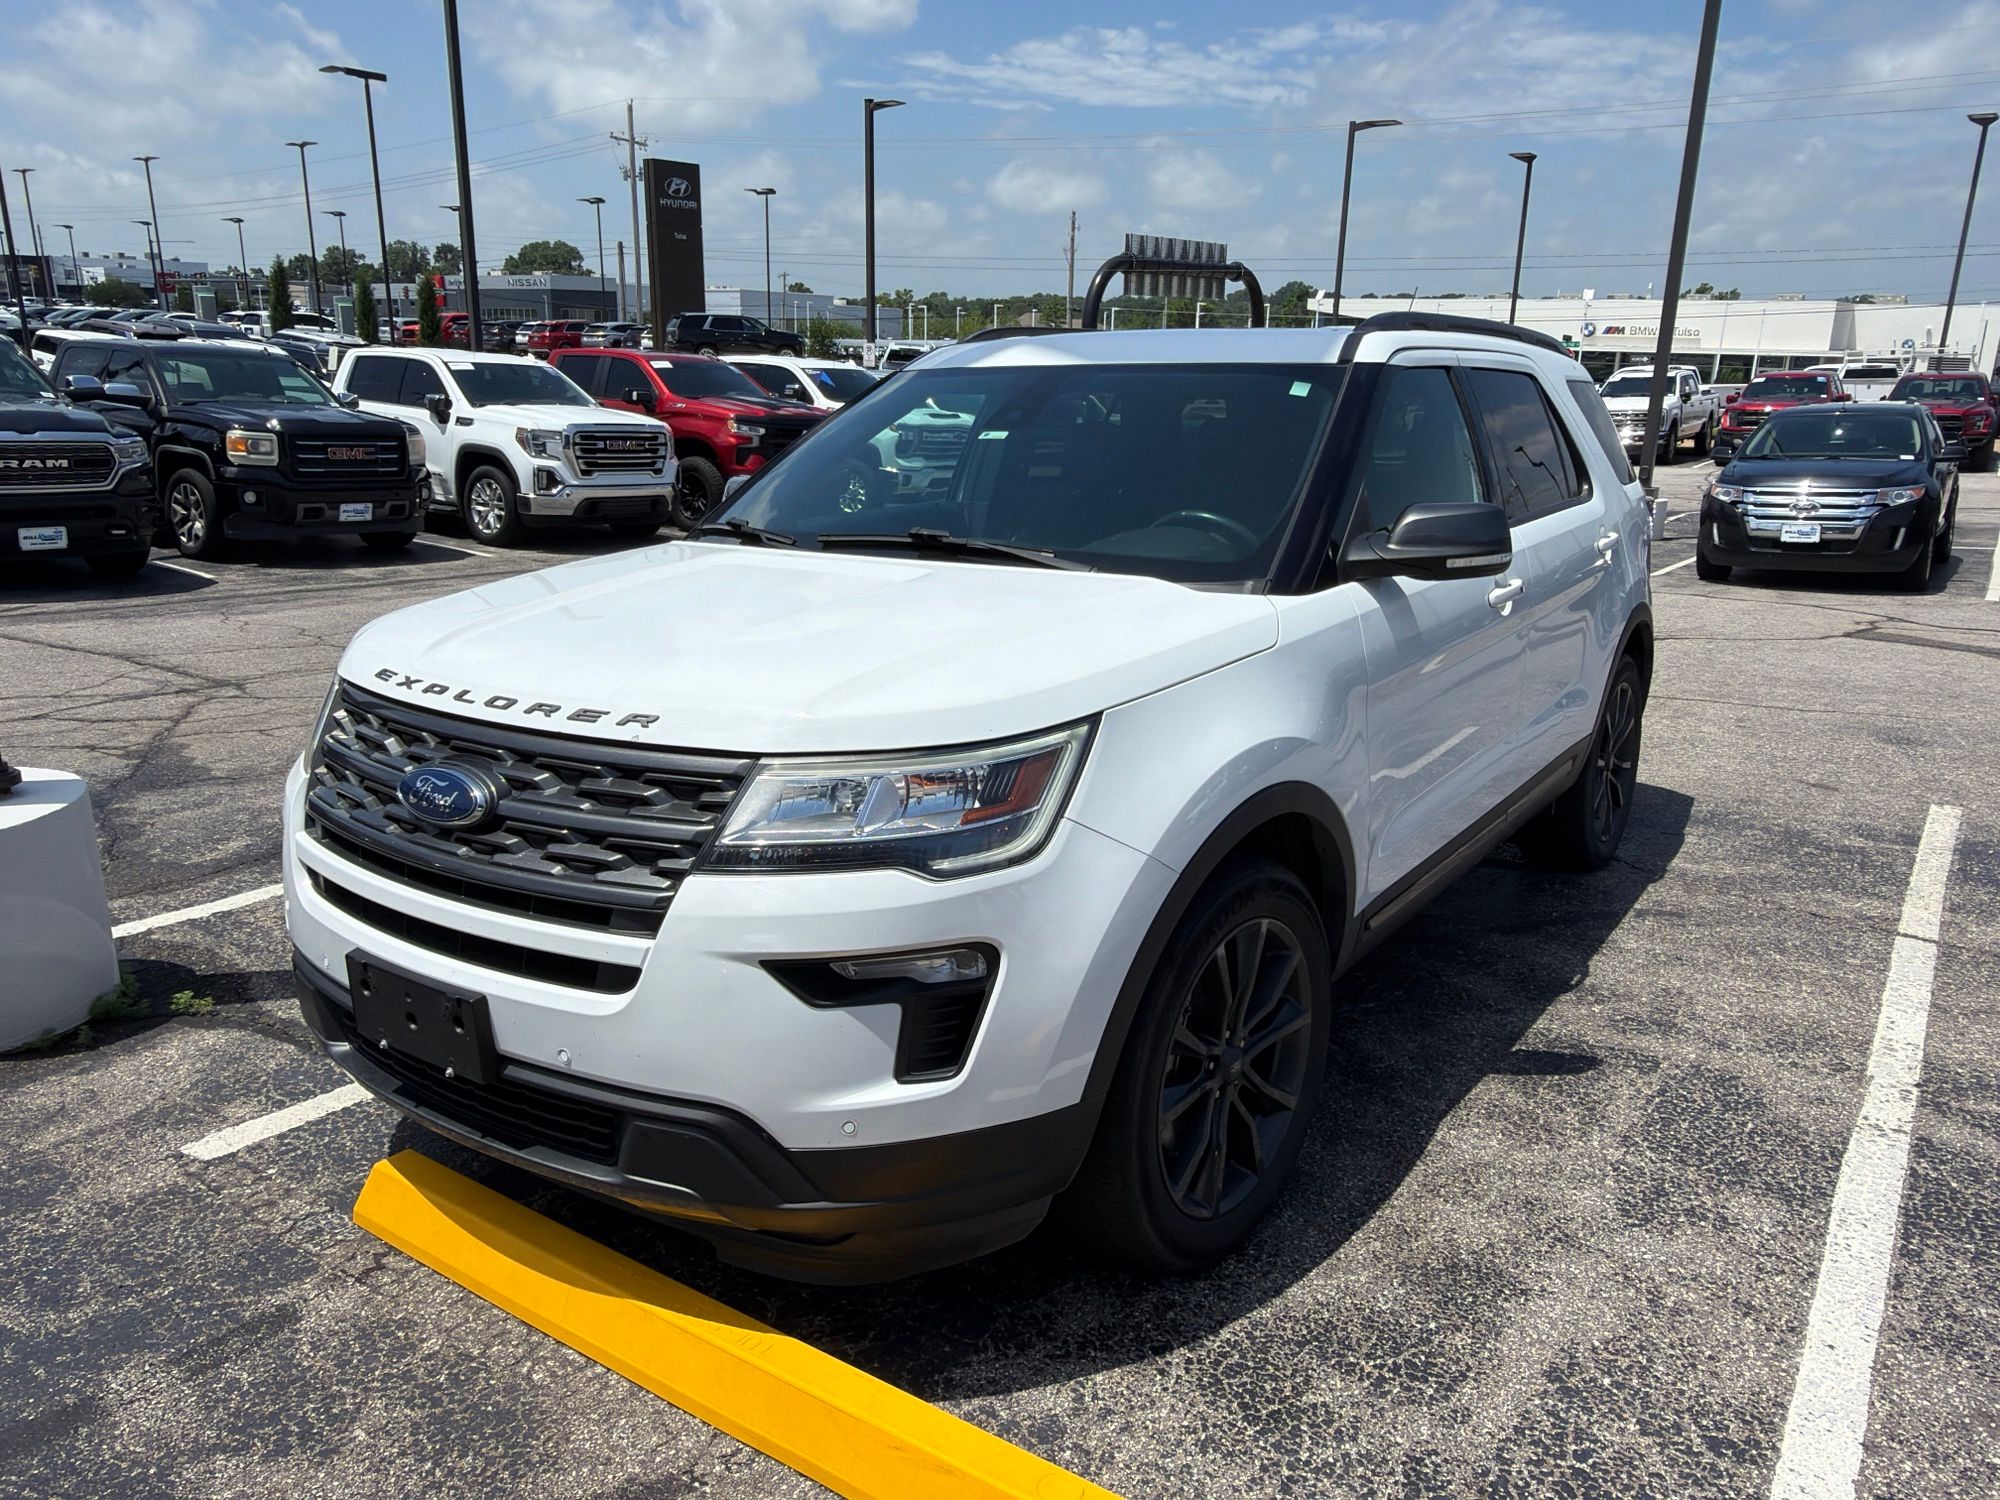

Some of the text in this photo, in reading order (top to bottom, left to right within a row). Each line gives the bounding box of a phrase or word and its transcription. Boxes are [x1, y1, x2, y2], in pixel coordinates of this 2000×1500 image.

[660, 198, 697, 209] HYUNDAI
[507, 278, 547, 287] NISSAN
[1629, 326, 1658, 336] BMW
[1673, 326, 1700, 337] Tulsa
[328, 447, 377, 460] GMC
[0, 459, 69, 468] RAM
[374, 667, 660, 729] EXPLORER
[415, 775, 460, 806] Ford
